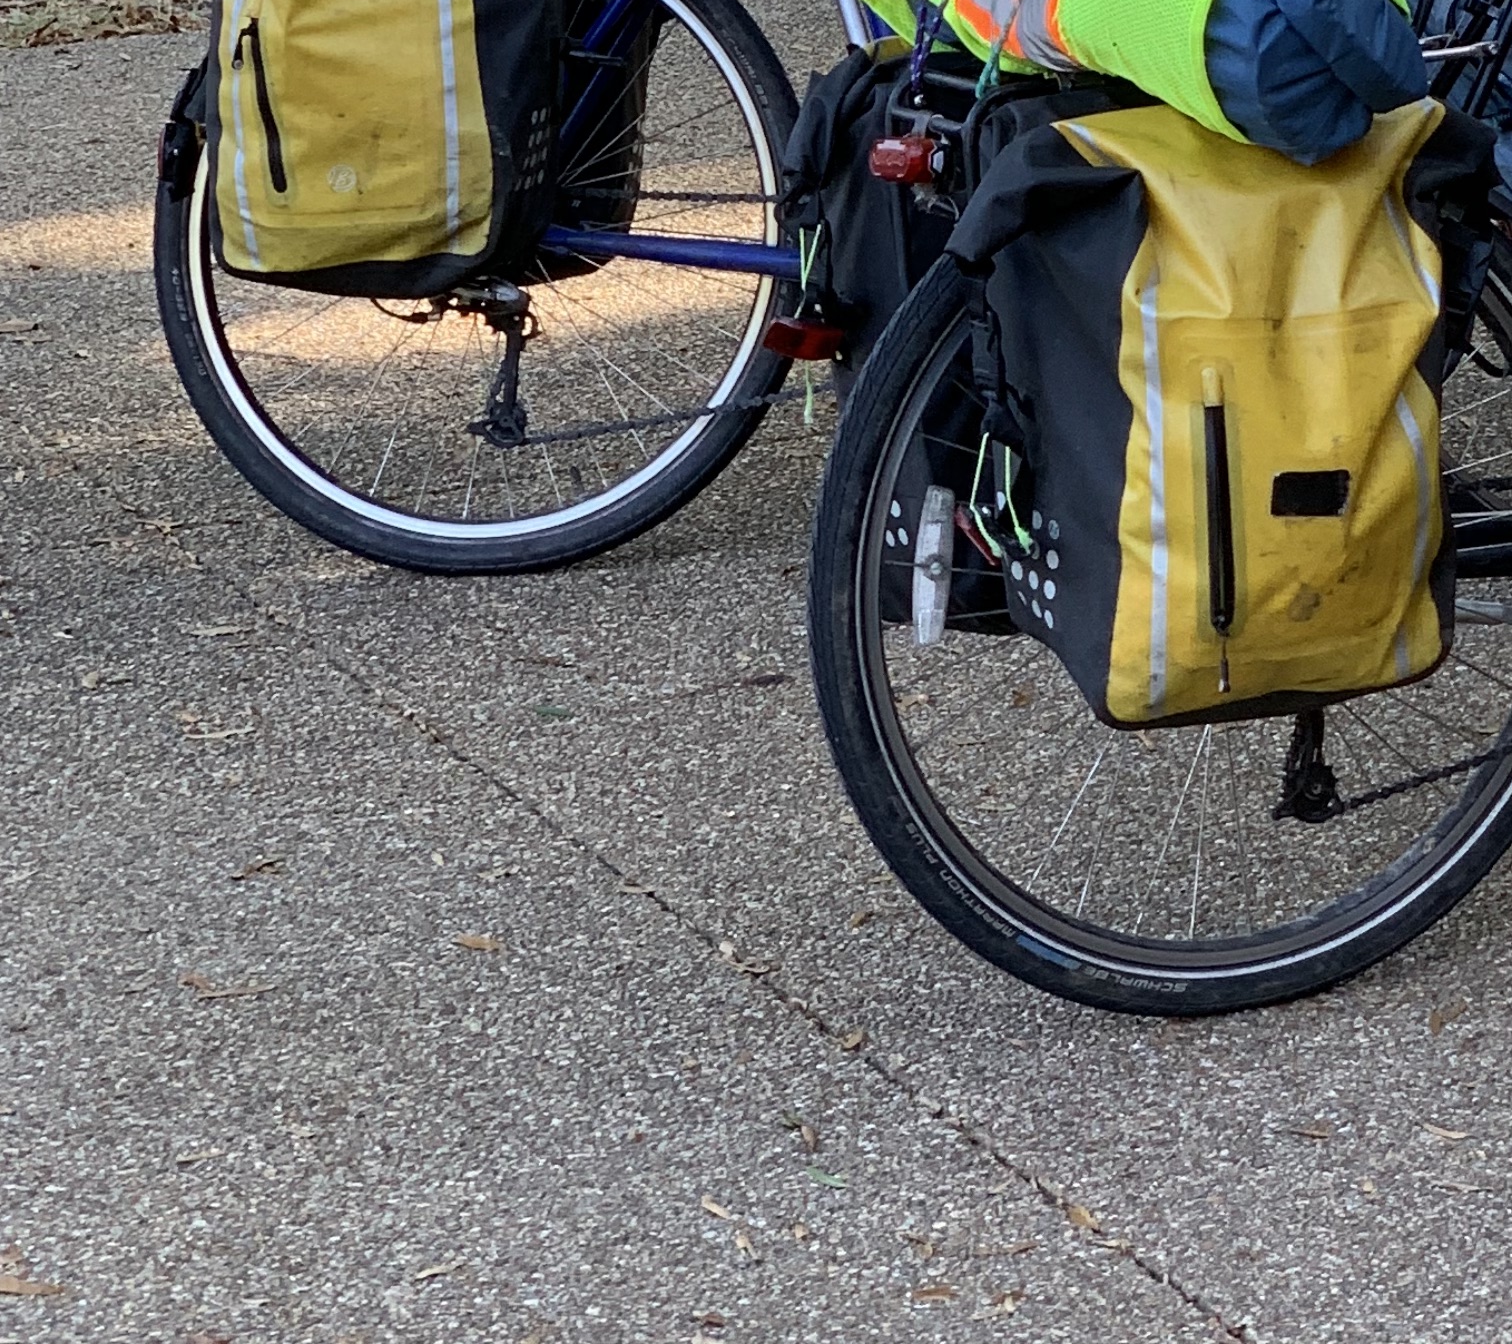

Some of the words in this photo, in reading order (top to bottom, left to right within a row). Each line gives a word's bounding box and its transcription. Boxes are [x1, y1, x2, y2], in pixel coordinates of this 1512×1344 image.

[904, 821, 939, 865] PLUS
[938, 868, 1018, 939] MARATHON
[1082, 965, 1191, 994] SCHWALBE
